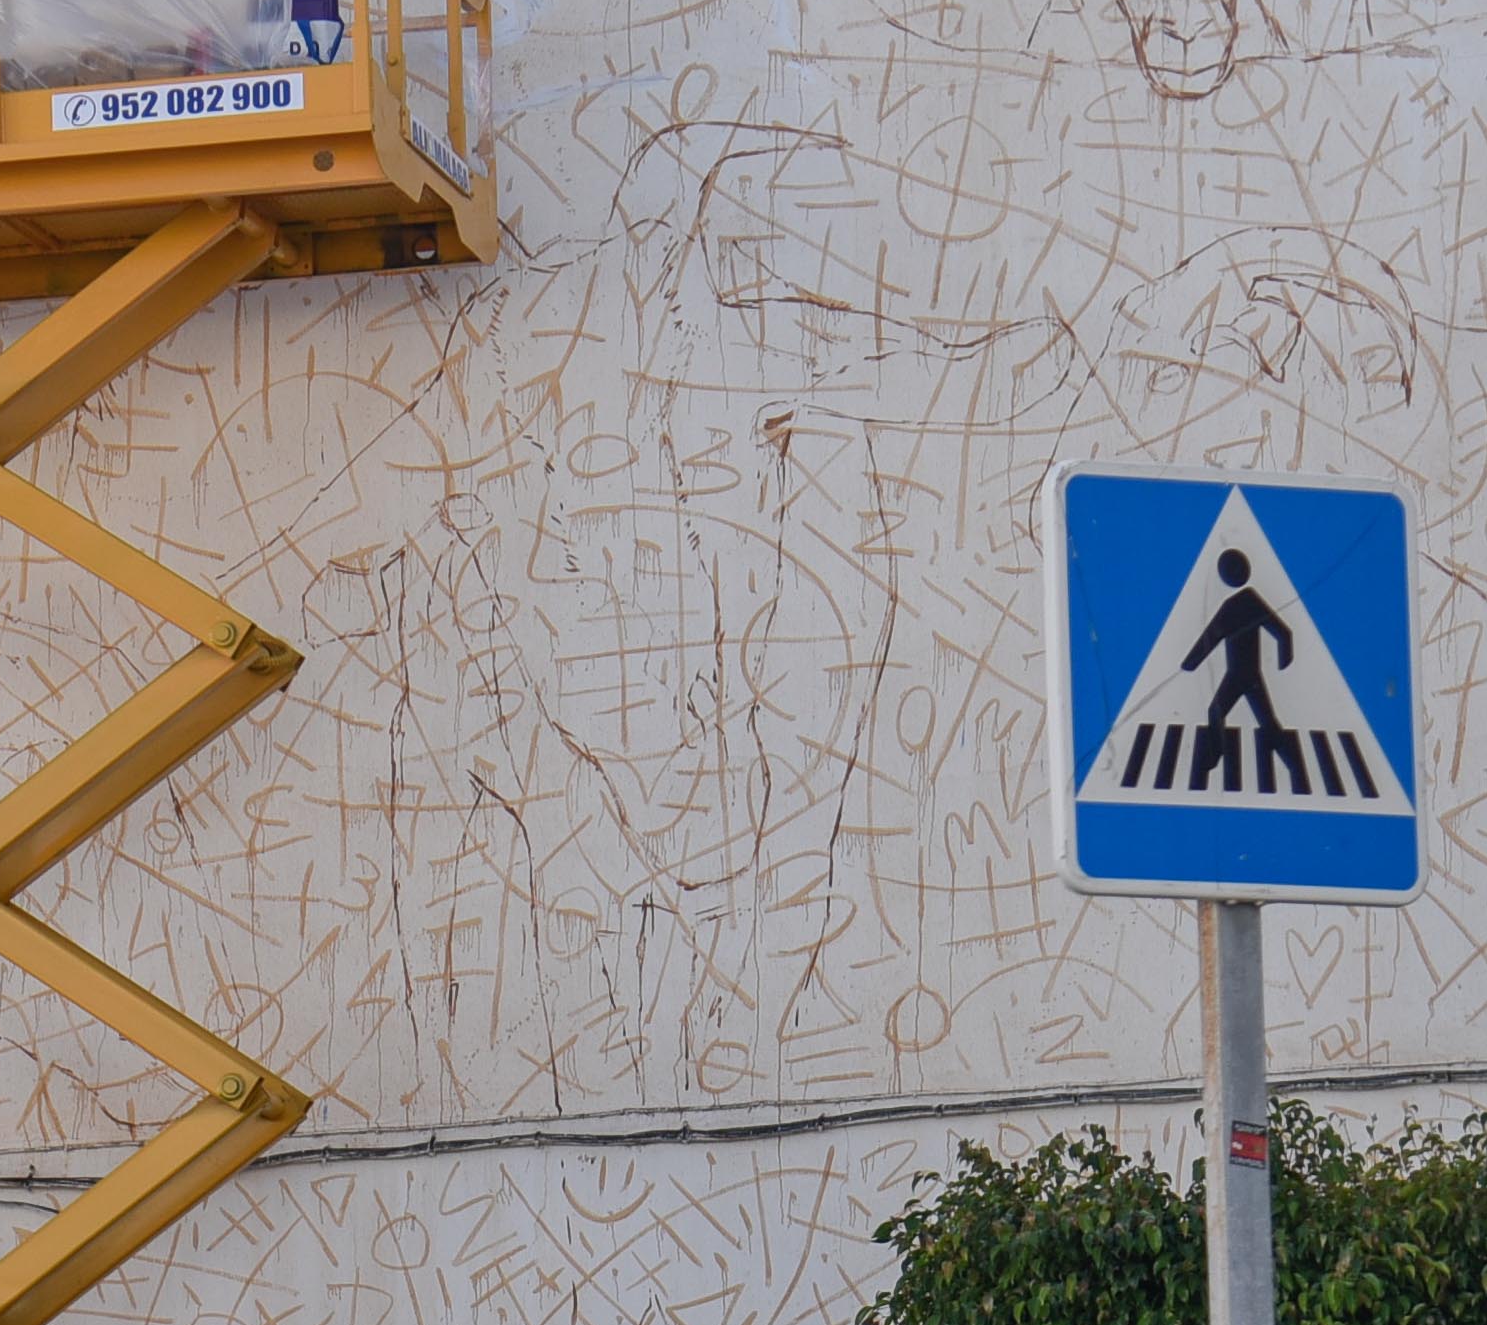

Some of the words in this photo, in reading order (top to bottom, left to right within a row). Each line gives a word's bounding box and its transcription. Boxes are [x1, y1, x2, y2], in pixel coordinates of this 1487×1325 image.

[101, 91, 159, 122] 952
[166, 85, 225, 116] 082
[232, 78, 292, 111] 900
